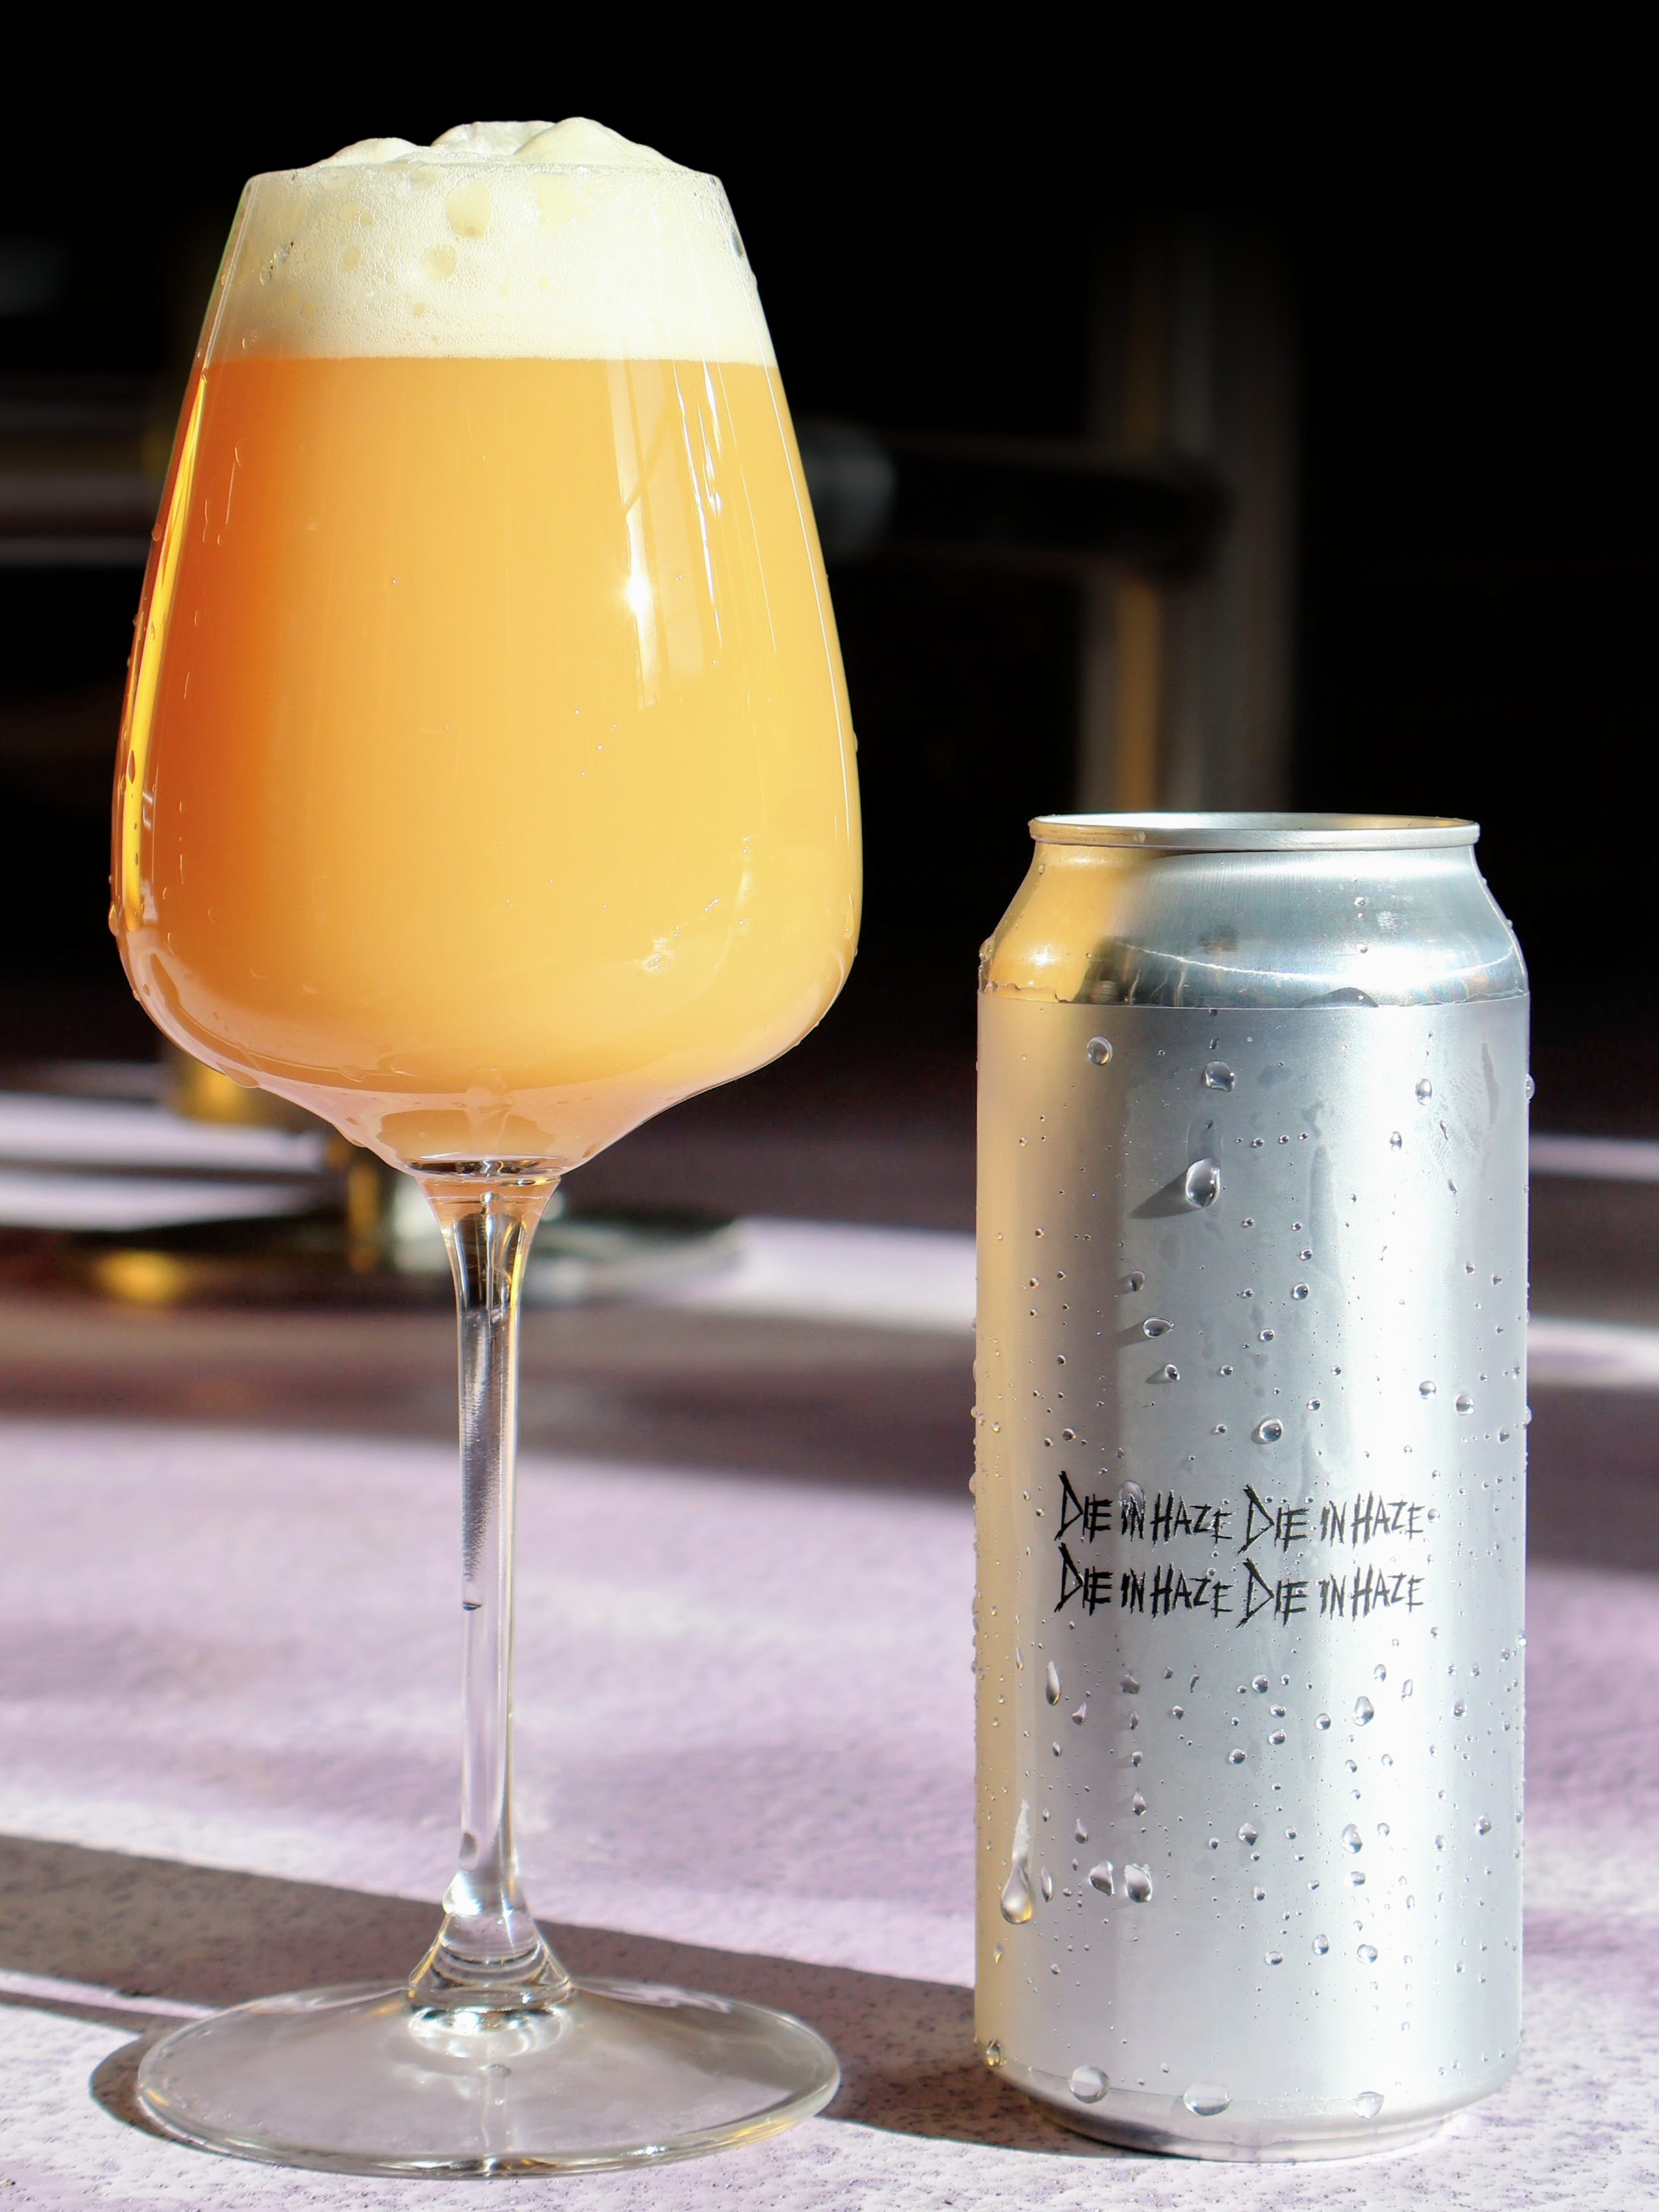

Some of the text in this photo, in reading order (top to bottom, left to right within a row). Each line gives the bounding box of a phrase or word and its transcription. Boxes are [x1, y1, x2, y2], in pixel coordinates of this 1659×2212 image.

[1054, 1470, 1113, 1543] DIE
[1238, 1484, 1310, 1553] DIE
[1054, 1543, 1113, 1615] DIE
[1236, 1558, 1309, 1628] DIE
